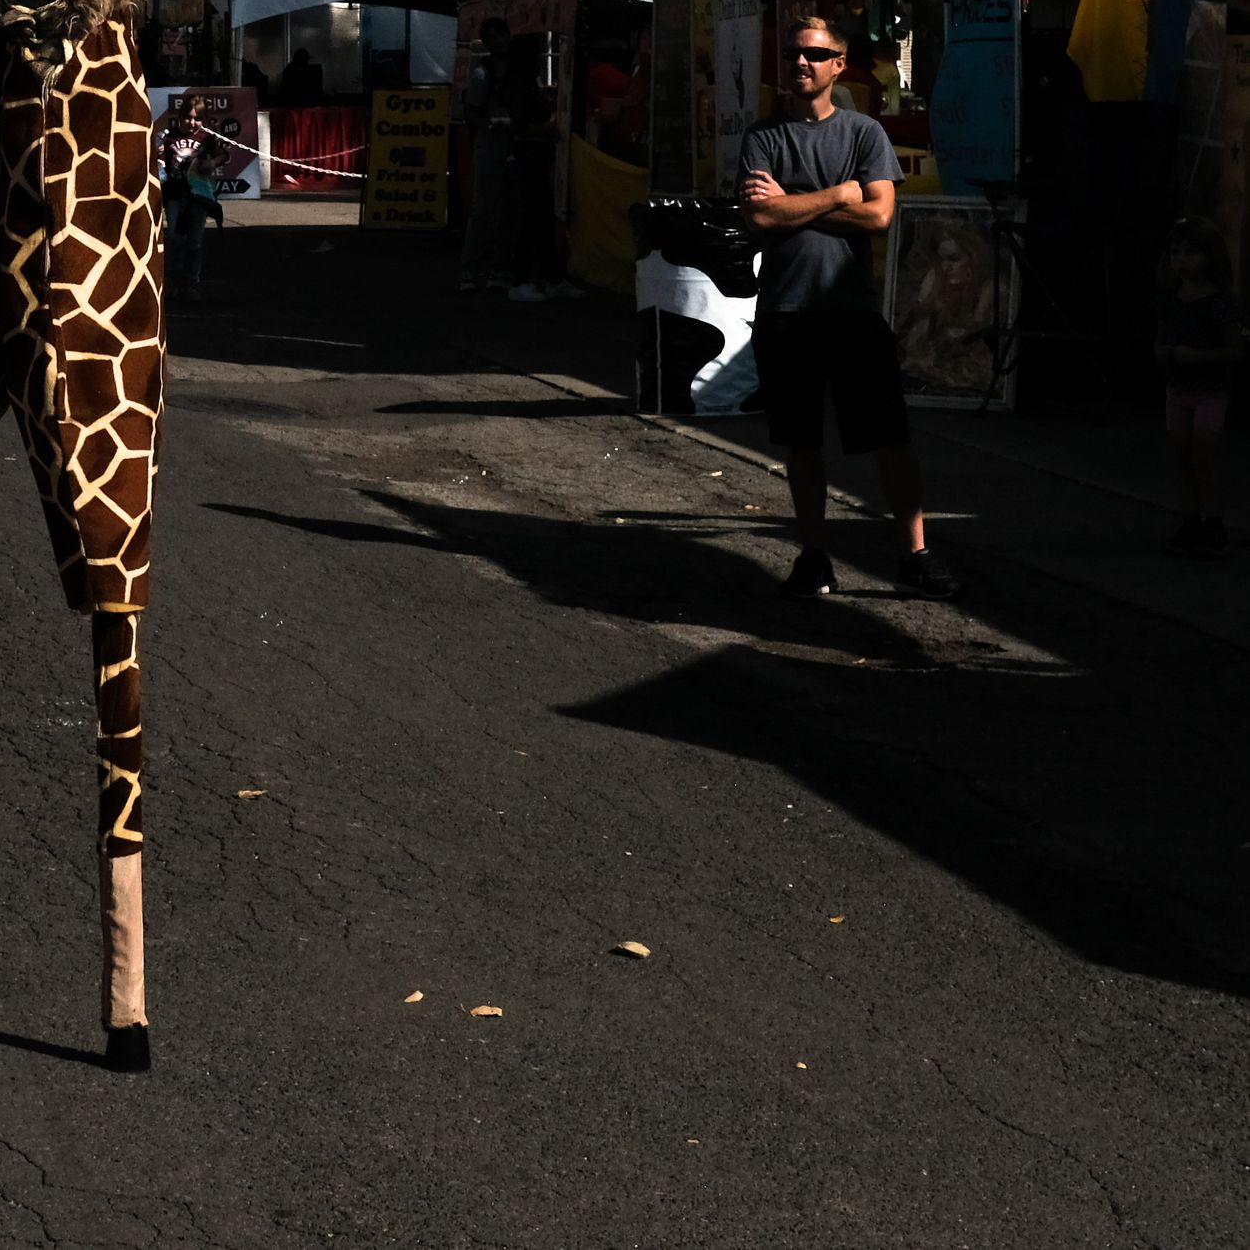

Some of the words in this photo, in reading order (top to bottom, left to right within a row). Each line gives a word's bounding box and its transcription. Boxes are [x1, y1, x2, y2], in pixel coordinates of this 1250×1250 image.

[386, 94, 436, 113] Gyro
[375, 120, 446, 137] Combo
[375, 169, 416, 182] Fries
[420, 172, 438, 182] or
[374, 188, 418, 202] Salad
[422, 190, 437, 202] &
[372, 212, 381, 221] a
[385, 209, 435, 223] Drink
